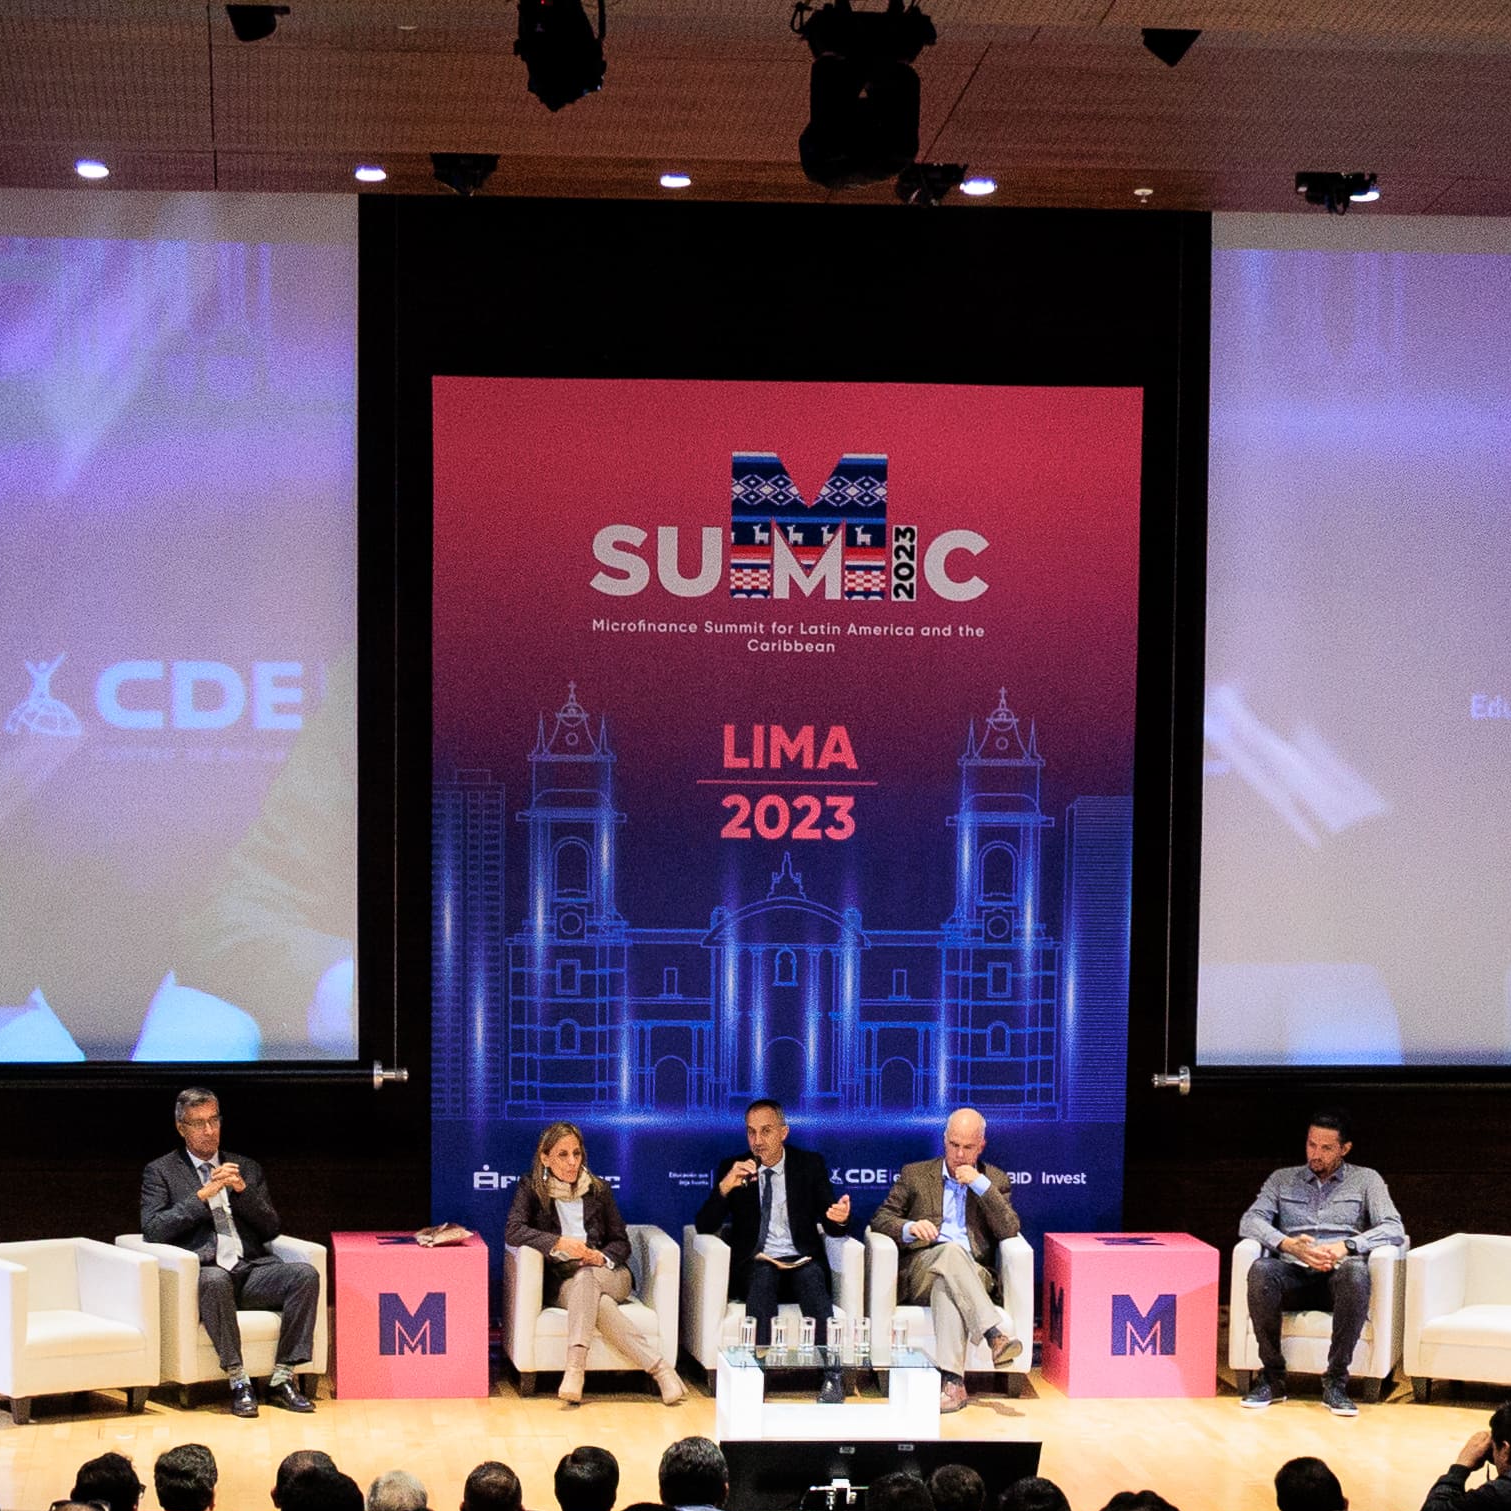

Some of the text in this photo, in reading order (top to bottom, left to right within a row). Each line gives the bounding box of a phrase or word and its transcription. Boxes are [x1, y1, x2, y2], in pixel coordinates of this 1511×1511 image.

[892, 526, 916, 600] 2023
[592, 618, 986, 638] Microfinance Summit for Latin America and the
[746, 638, 836, 653] Caribbean
[97, 660, 304, 731] CDE
[722, 724, 859, 770] LIMA
[720, 793, 857, 841] 2023
[844, 1168, 888, 1184] CDE
[1007, 1171, 1088, 1185] BID Invest
